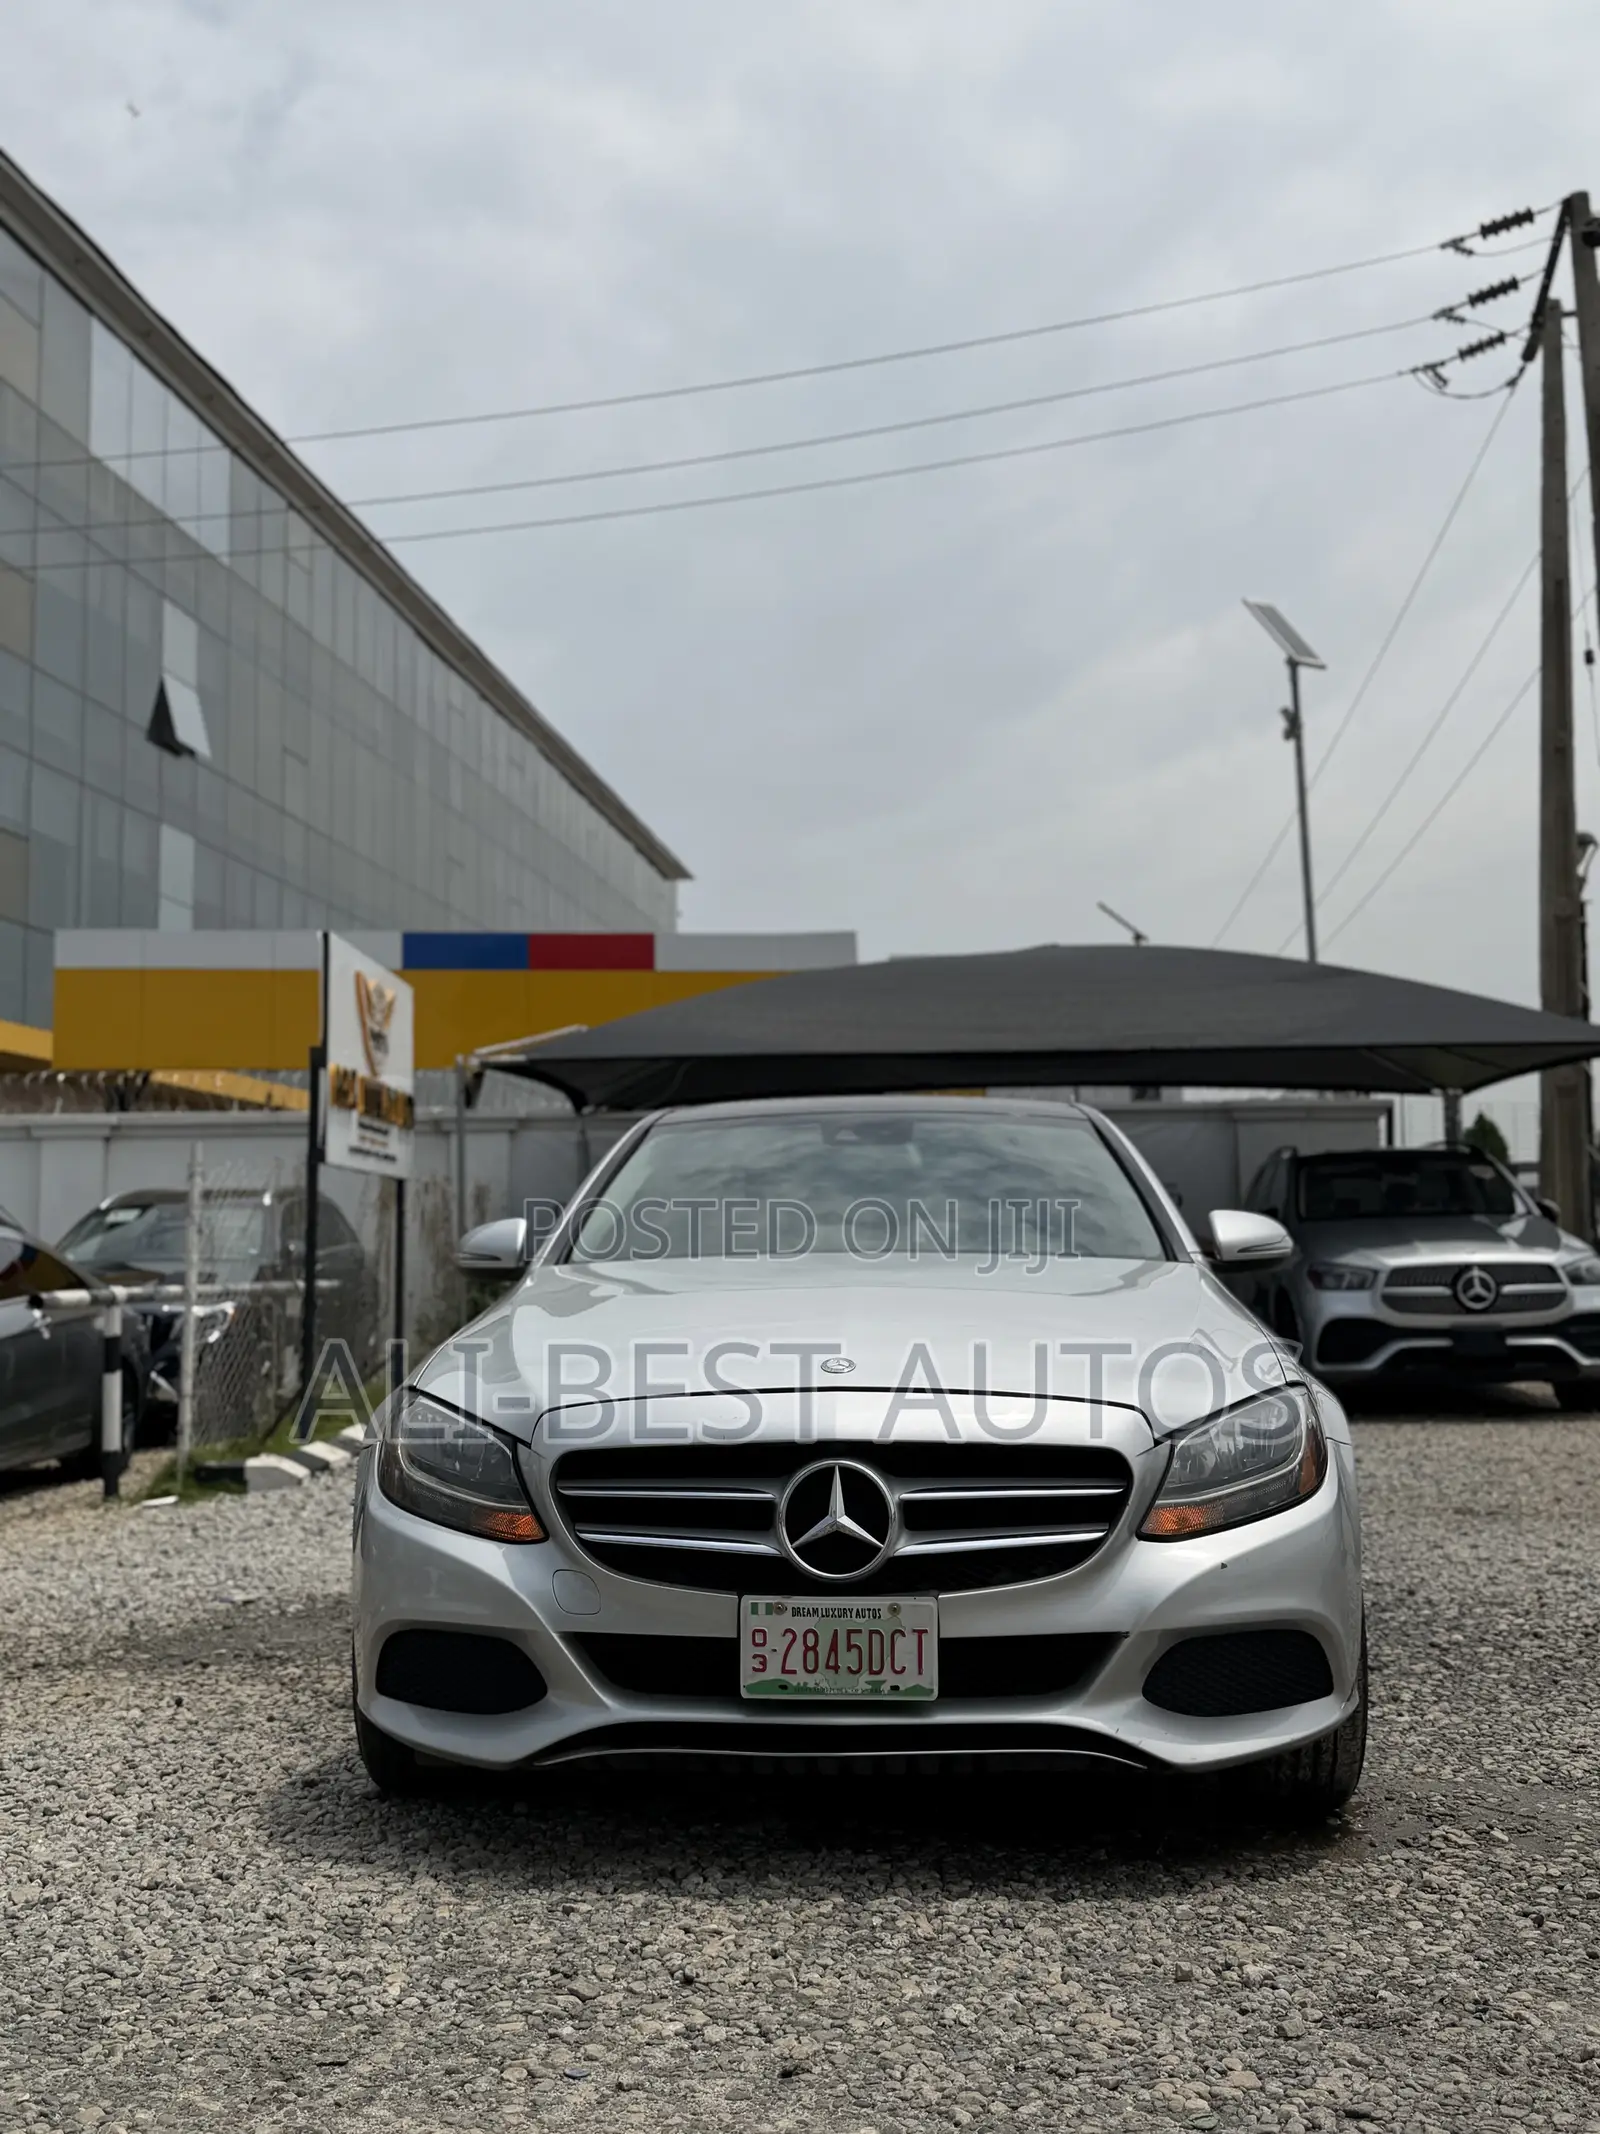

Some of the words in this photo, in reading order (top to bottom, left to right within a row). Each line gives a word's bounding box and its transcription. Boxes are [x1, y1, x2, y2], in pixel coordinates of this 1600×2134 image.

[791, 1606, 819, 1618] DREAM
[820, 1607, 853, 1619] LUXURY
[855, 1607, 882, 1620] AUTOS
